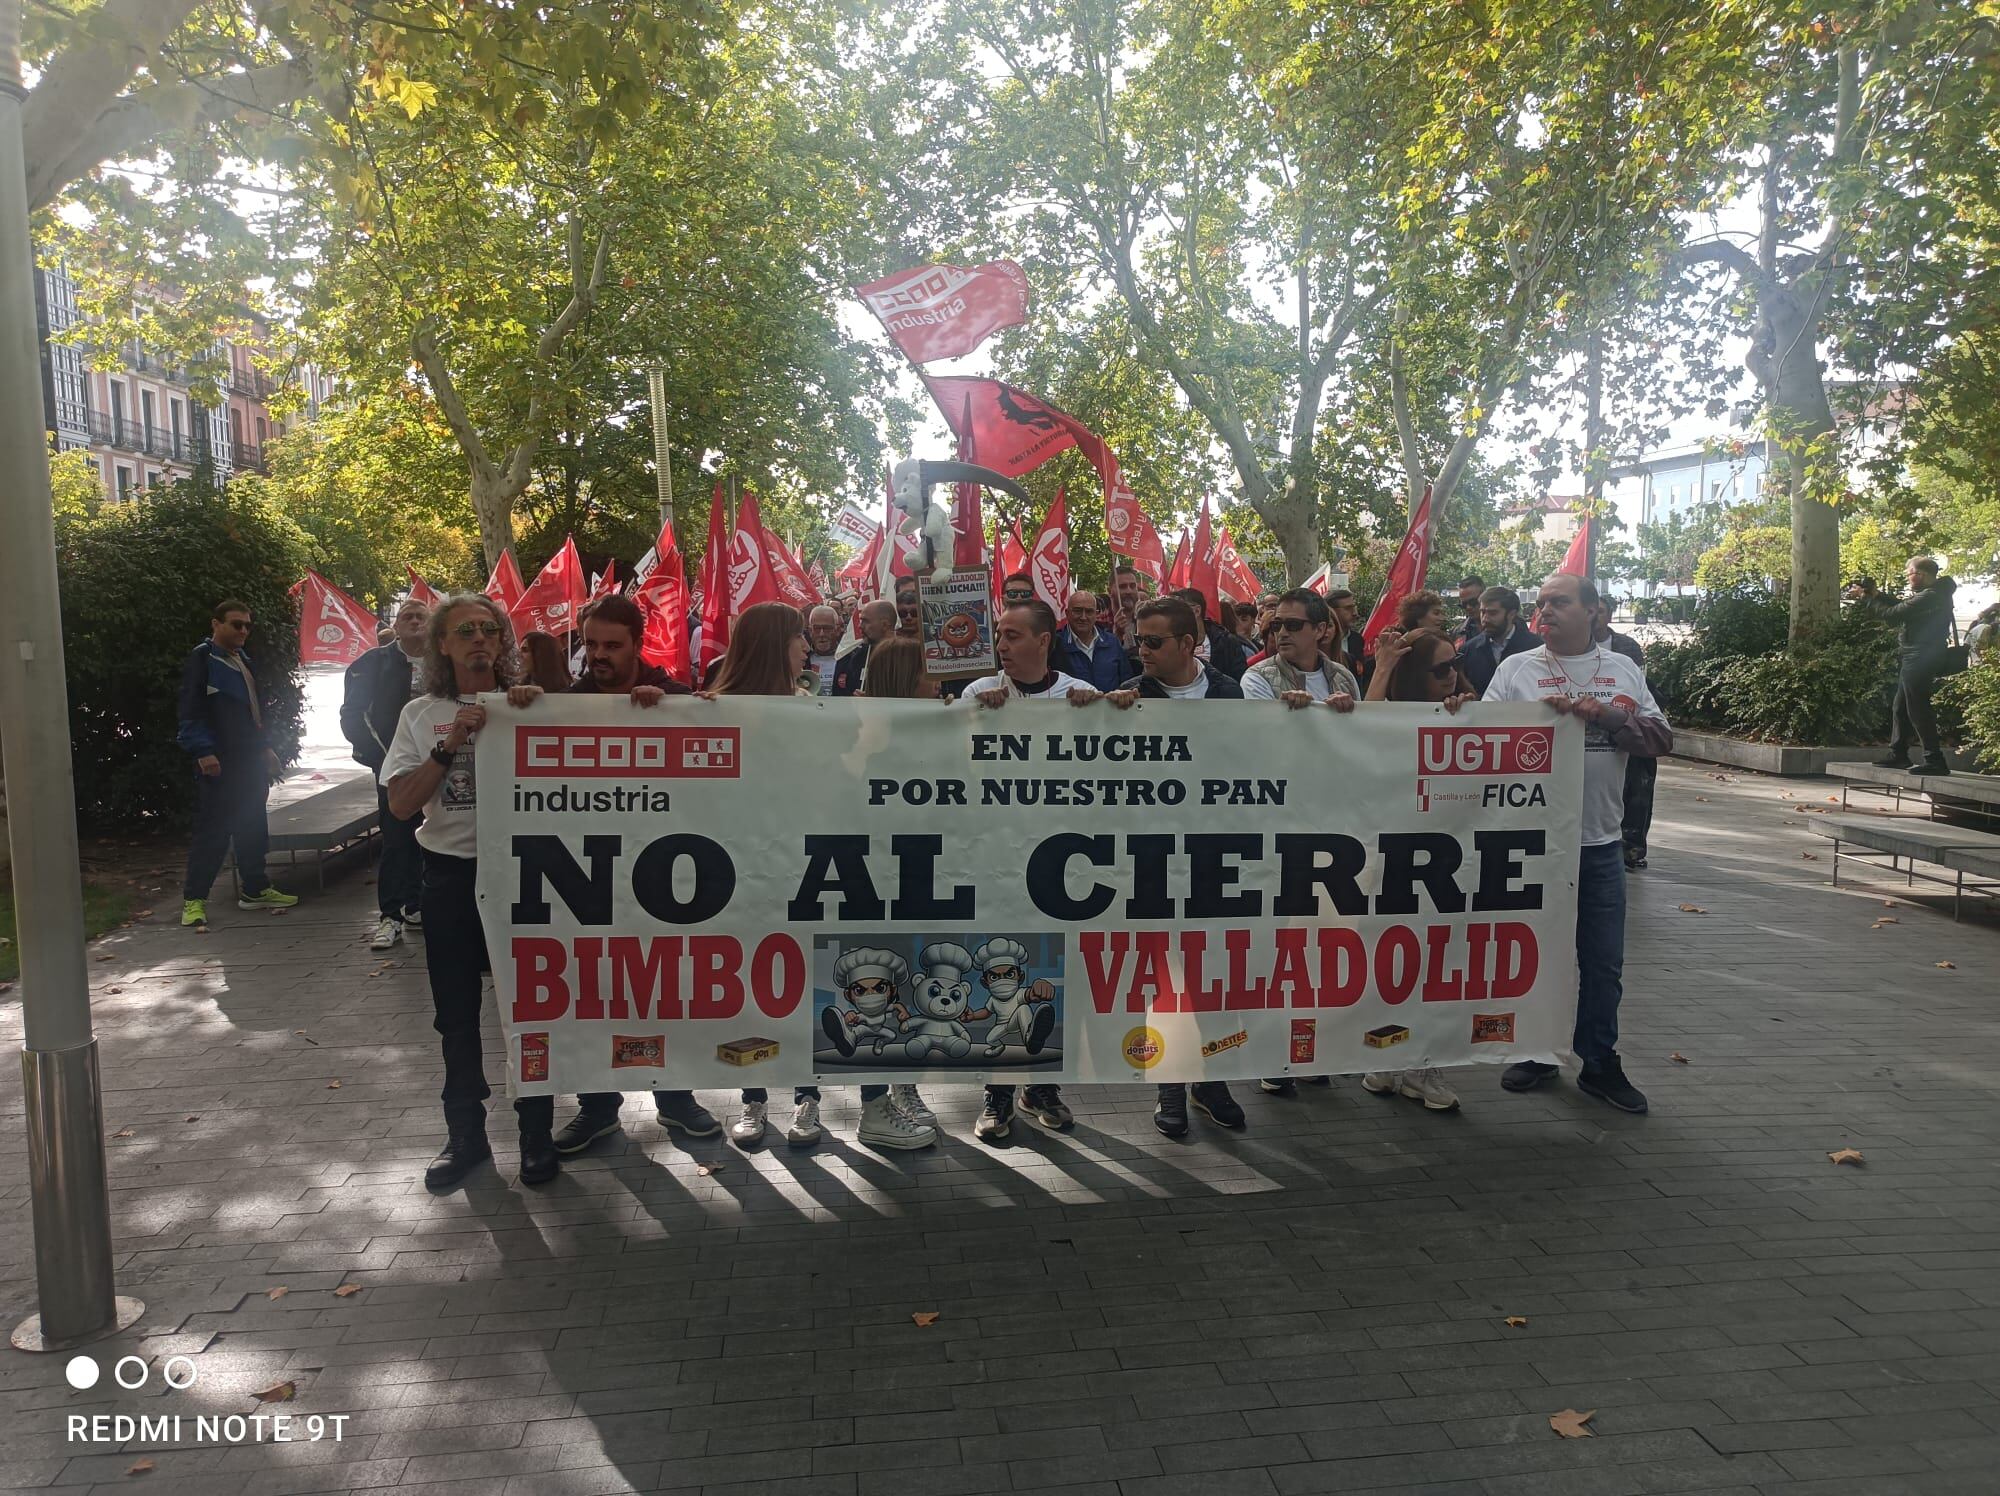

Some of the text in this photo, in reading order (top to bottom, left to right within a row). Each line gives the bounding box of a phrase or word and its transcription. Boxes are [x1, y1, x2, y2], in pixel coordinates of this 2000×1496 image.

[875, 271, 949, 311] CCOO
[527, 736, 666, 769] CCOO
[972, 734, 1192, 762] EN LUCHA
[1423, 733, 1511, 772] UGT
[514, 785, 671, 812] industria
[869, 778, 1287, 806] POR NUESTRO PAN
[1433, 793, 1459, 801] Castilla
[1465, 792, 1480, 800] León
[1482, 783, 1547, 807] FICA
[511, 829, 1546, 925] NO AL CIERRE
[511, 922, 1540, 1023] BIMBO VALLADOLID
[1126, 1043, 1159, 1056] donuts
[1202, 1031, 1248, 1055] DONETTES
